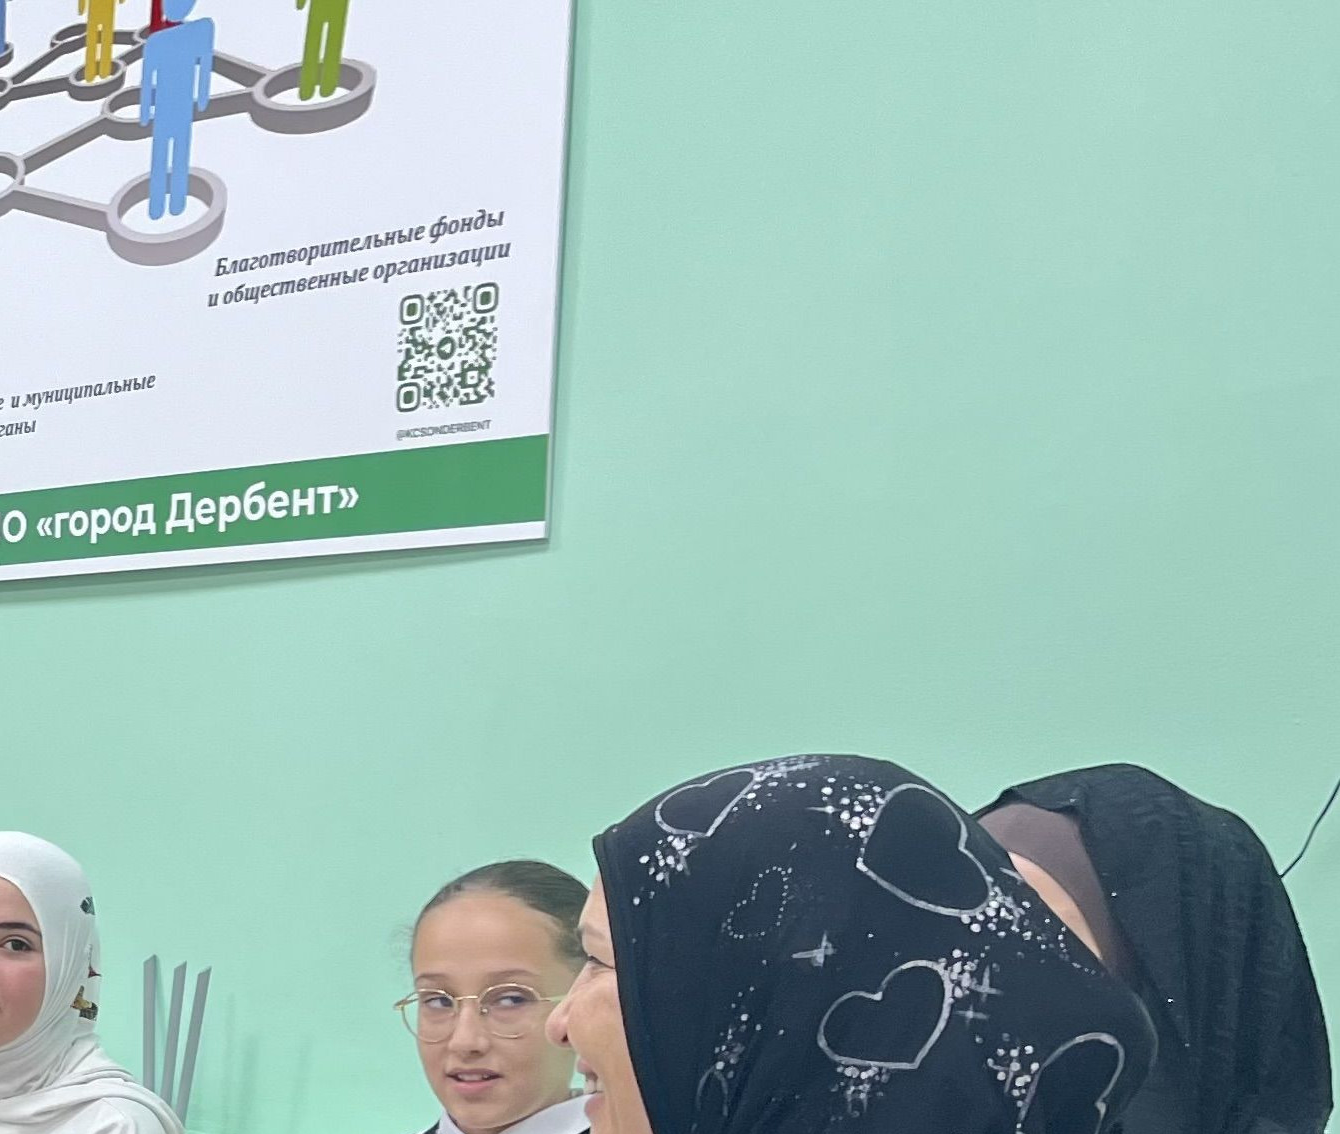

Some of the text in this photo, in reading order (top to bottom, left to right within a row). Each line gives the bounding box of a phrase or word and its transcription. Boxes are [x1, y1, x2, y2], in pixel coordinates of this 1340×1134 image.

[208, 242, 511, 308] и общественные организации
[214, 208, 505, 278] Благотворительные фонды
[10, 394, 20, 409] и
[23, 374, 157, 412] муниципальные
[37, 502, 156, 544] «город
[166, 481, 360, 535] Дербент»
